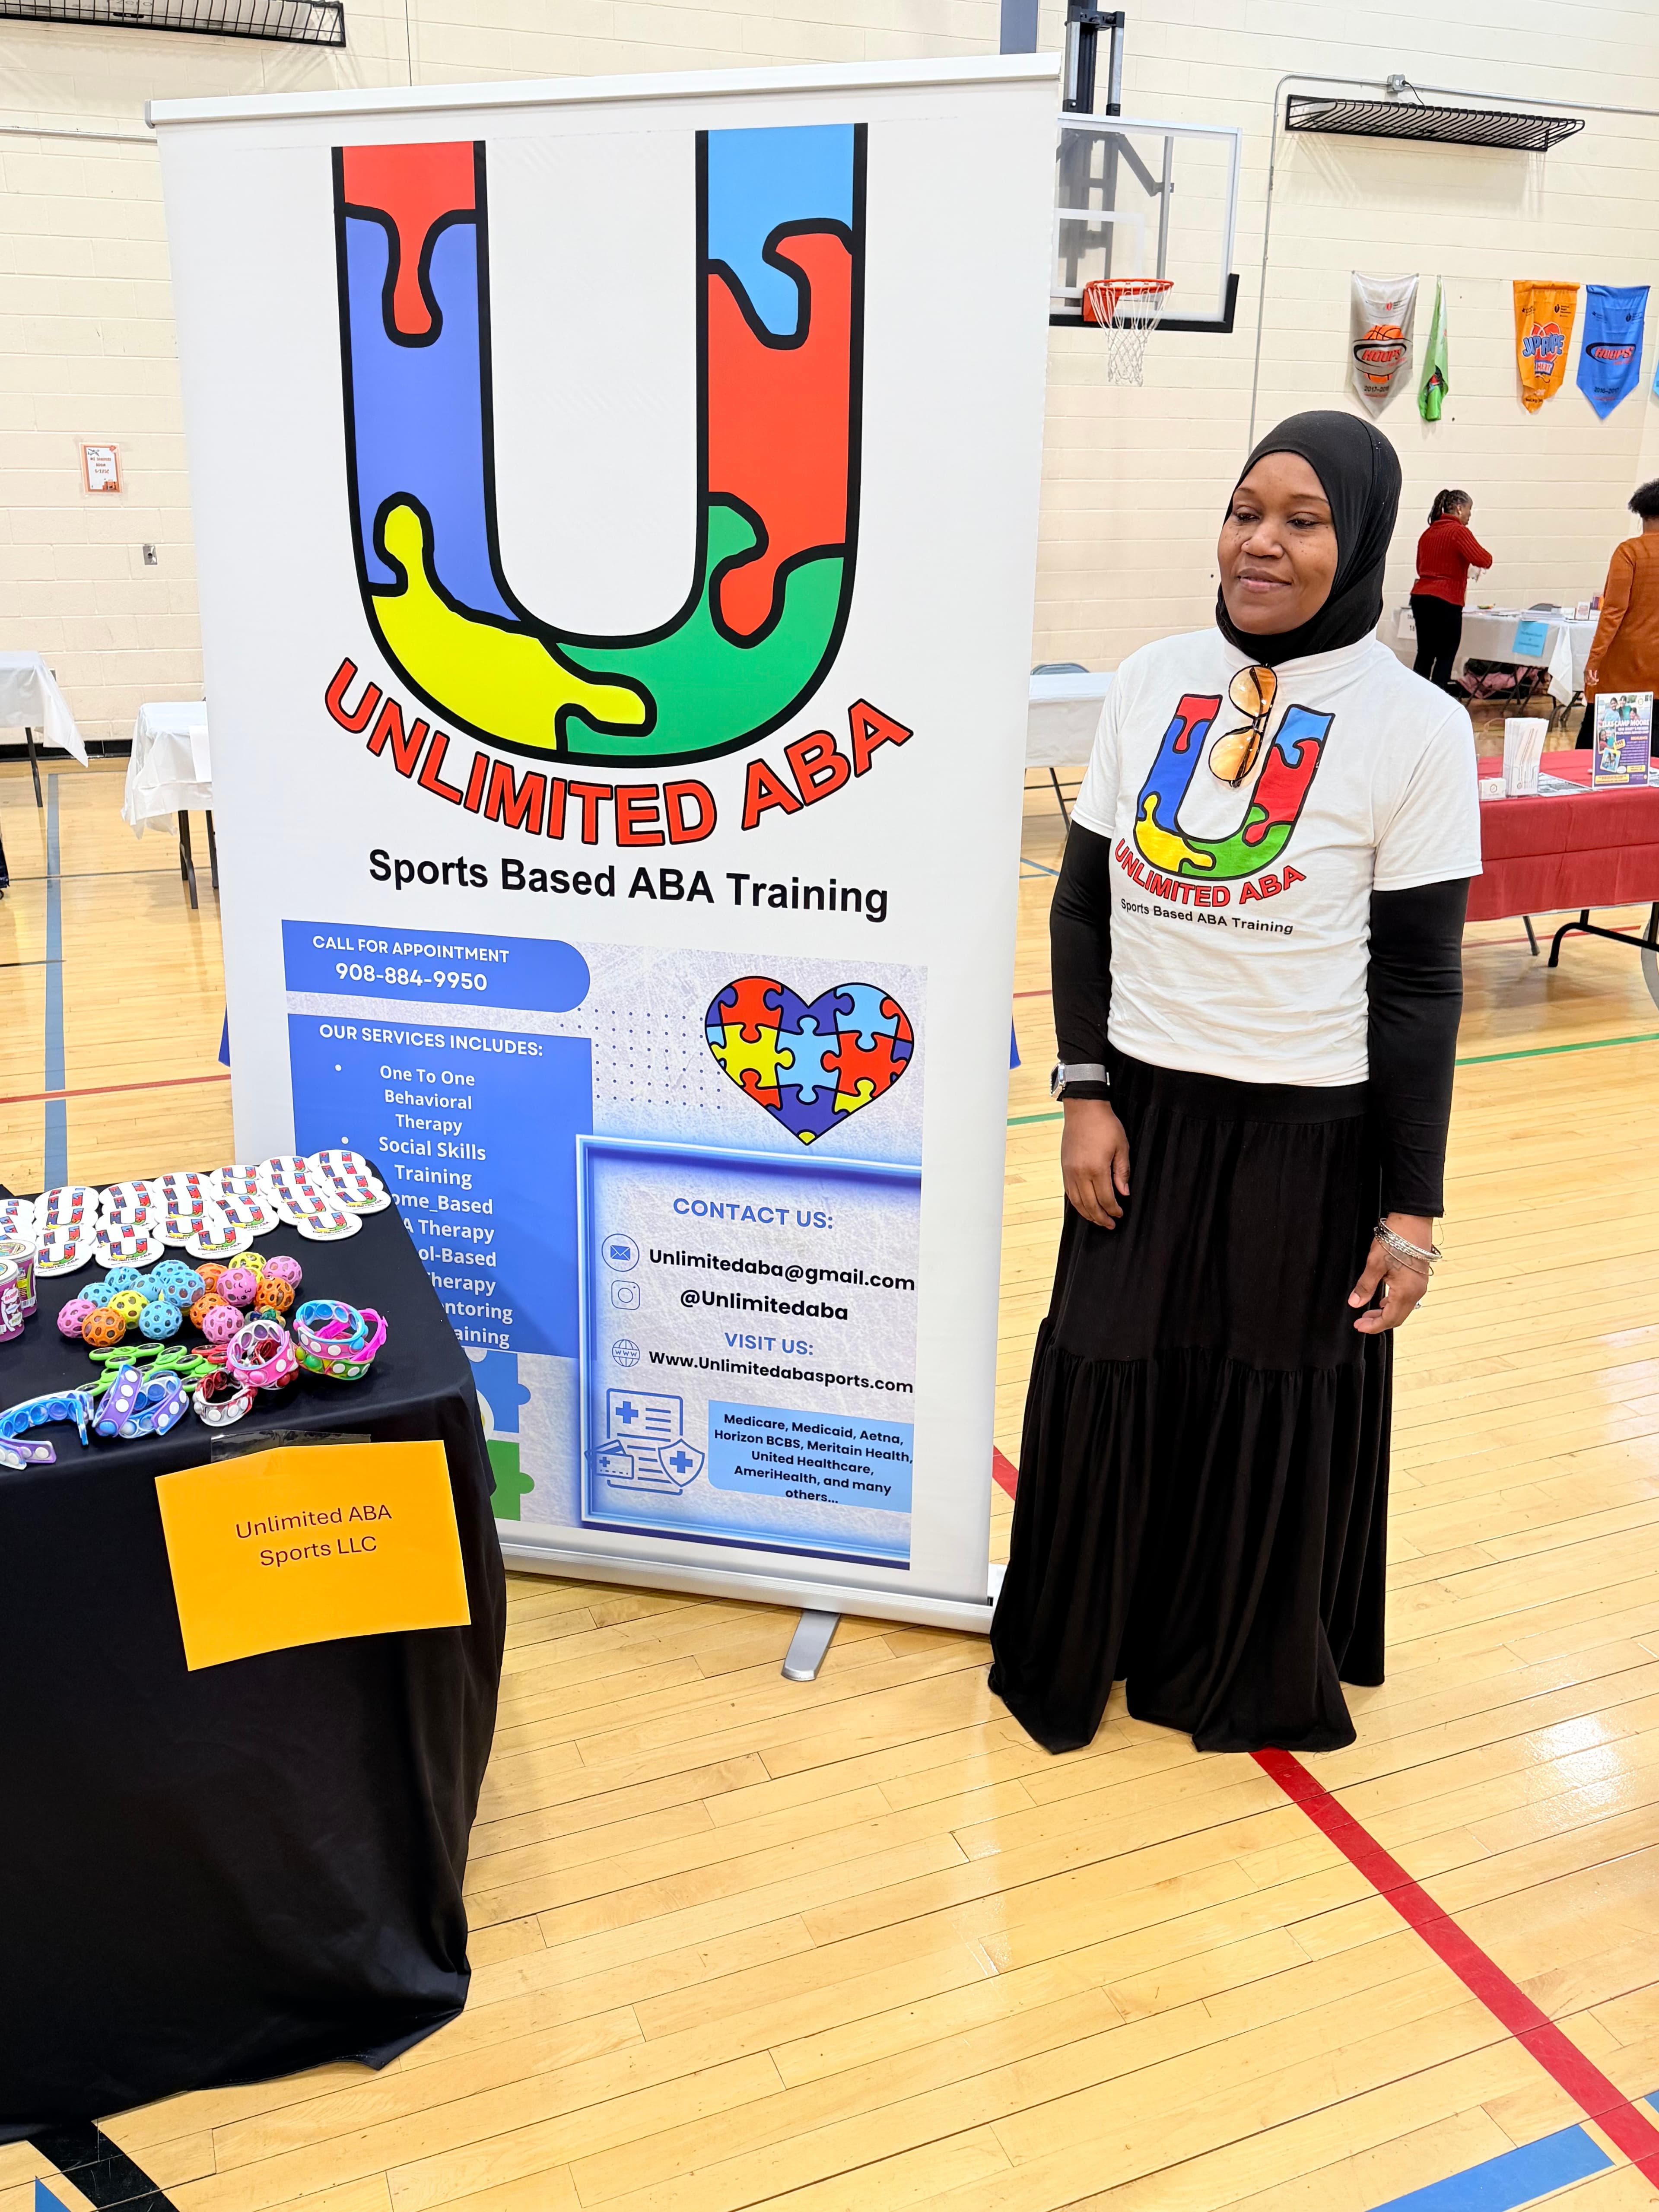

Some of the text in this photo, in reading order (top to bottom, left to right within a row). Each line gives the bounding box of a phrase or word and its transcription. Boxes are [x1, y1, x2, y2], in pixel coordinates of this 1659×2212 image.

[1361, 349, 1402, 362] HOOPS
[1594, 346, 1634, 359] HOOPS
[324, 657, 914, 847] UNLIMITED ABA
[369, 849, 888, 923] Sports Based ABA Training
[1115, 839, 1307, 907] UNLIMITED ABA
[1121, 899, 1294, 935] Sports Based ABA Training
[312, 935, 510, 963] CALL FOR APPOINTMENT
[335, 963, 488, 992] 908-884-9950
[319, 1024, 544, 1057] OUR SERVICES INCLUDES:
[380, 1065, 475, 1087] One To One
[384, 1089, 473, 1110] Behavioral
[395, 1113, 463, 1137] Therapy
[379, 1137, 487, 1160] Social Skills
[394, 1164, 473, 1191] Training
[391, 1193, 493, 1215] ome_Based
[673, 1198, 834, 1230] CONTACT US:
[417, 1219, 495, 1245] Therapy
[418, 1246, 496, 1267] ol-Based
[649, 1249, 915, 1291] Unlimitedaba@gmail.com
[426, 1272, 496, 1297] herapy
[442, 1301, 513, 1325] ntoring
[680, 1289, 849, 1320] @Unlimitedaba
[455, 1326, 510, 1349] aining
[725, 1332, 814, 1356] VISIT US:
[649, 1351, 914, 1393] Www.Unlimitedabasports.com
[724, 1414, 904, 1446] Medicare, Medicaid, Aetna,
[714, 1430, 913, 1464] Horizon BCBS, Meritain Health,
[751, 1451, 874, 1476] United Healthcare,
[734, 1465, 892, 1497] AmeriHealth, and many
[785, 1489, 839, 1504] others...
[235, 1504, 392, 1539] Unlimited ABA
[260, 1536, 378, 1567] Sports LLC
